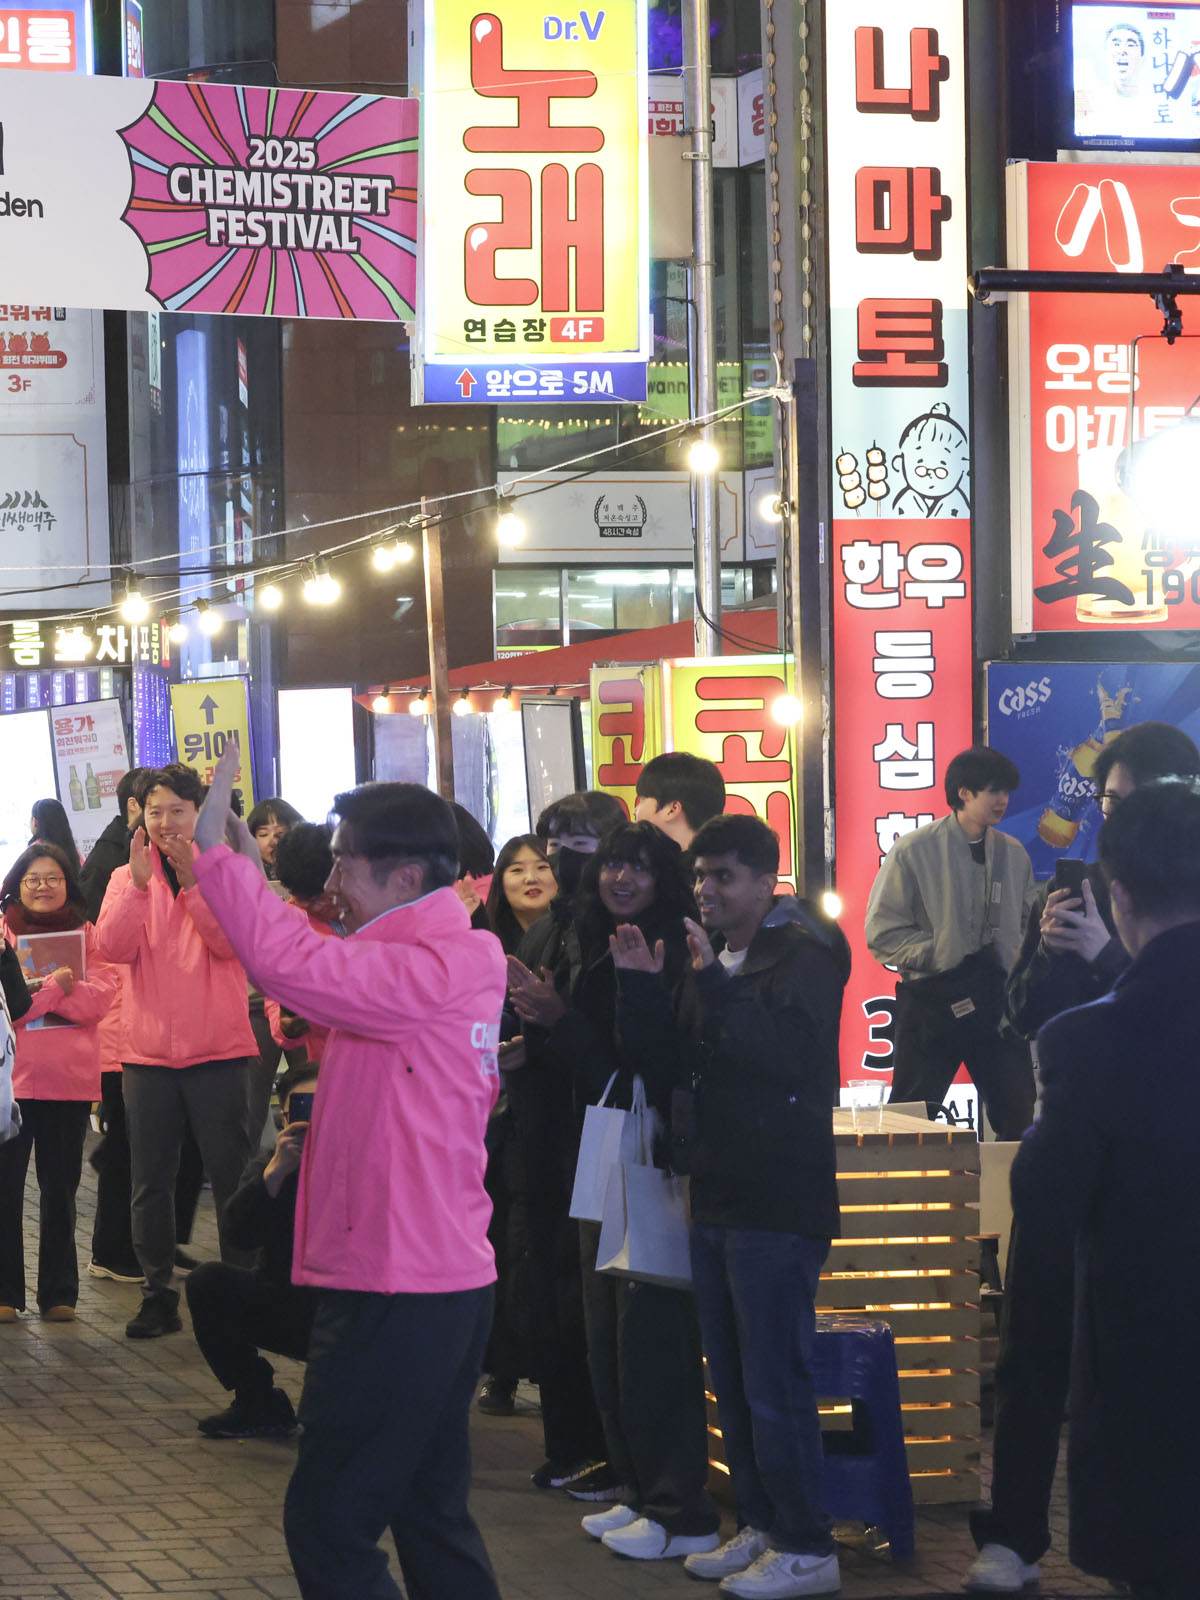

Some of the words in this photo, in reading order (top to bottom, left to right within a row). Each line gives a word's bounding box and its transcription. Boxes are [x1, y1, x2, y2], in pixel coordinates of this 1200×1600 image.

[543, 11, 605, 42] Dr.V
[249, 139, 316, 169] 2025
[463, 13, 605, 312] 노래
[169, 166, 393, 214] CHEMISTREET
[208, 210, 359, 252] FESTIVAL
[464, 318, 547, 343] 연습장
[561, 320, 593, 341] 4F
[7, 374, 32, 393] 3F
[486, 370, 565, 397] 앞으로
[573, 370, 614, 394] 5M
[1045, 343, 1141, 394] 오뎅
[1033, 489, 1136, 607] 生
